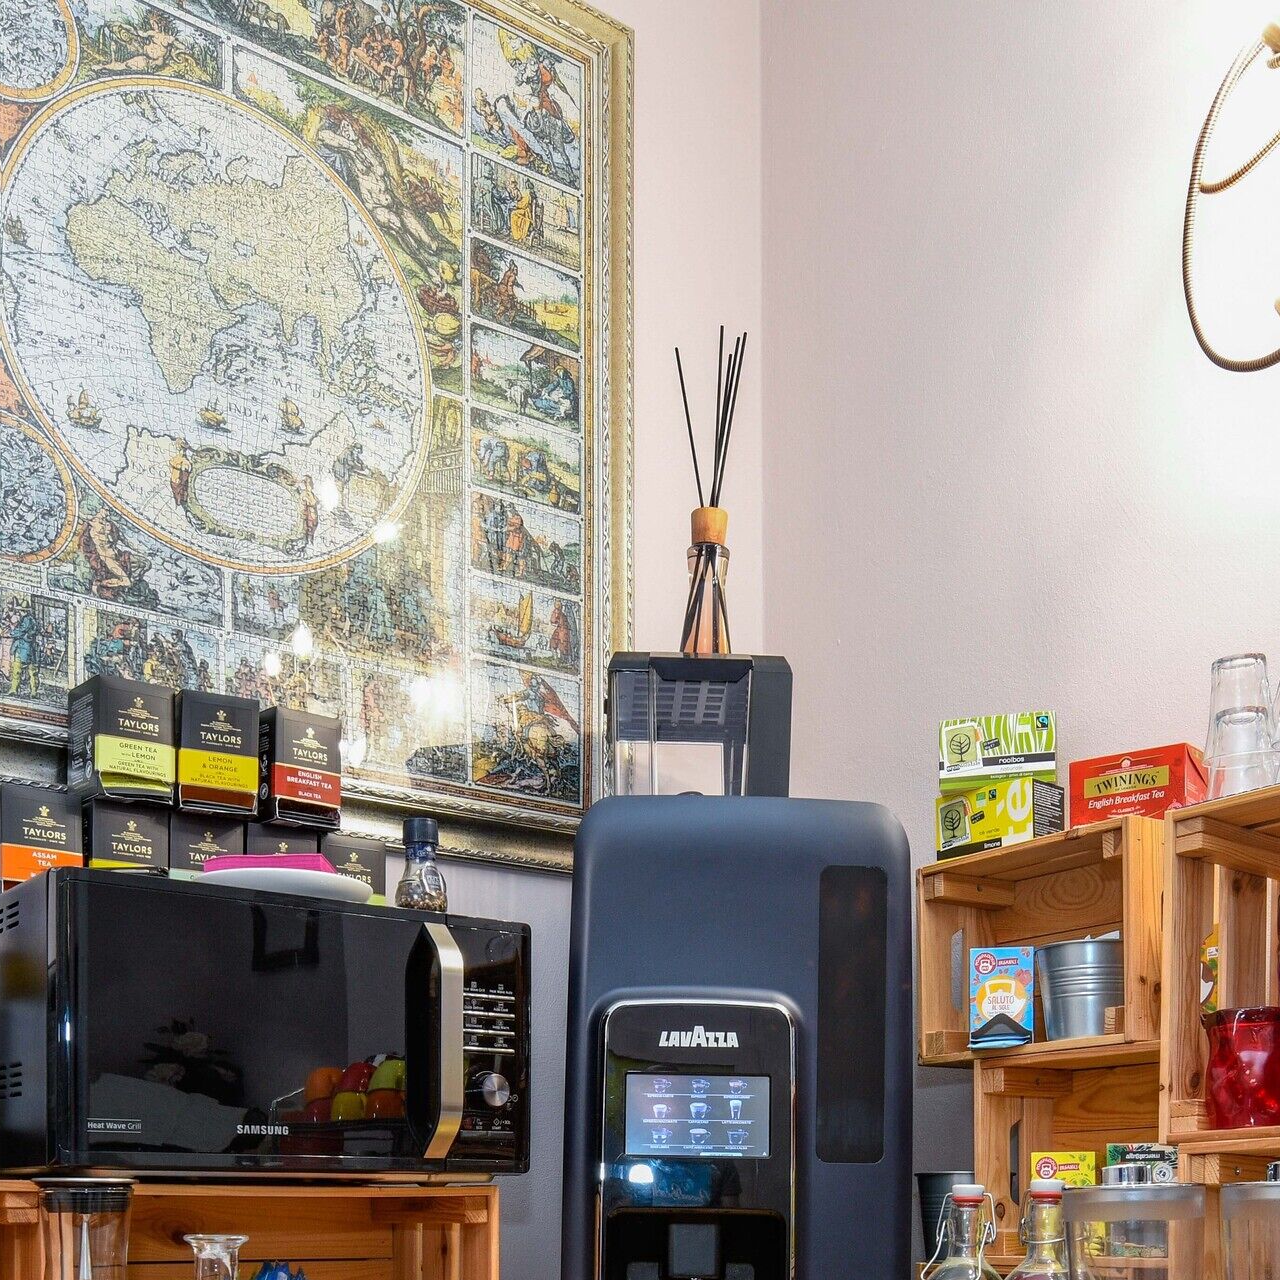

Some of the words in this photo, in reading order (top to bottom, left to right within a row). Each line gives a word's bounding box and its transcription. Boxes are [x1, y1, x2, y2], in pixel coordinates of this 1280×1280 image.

[228, 402, 270, 425] INDIA
[118, 718, 160, 733] TAYLORS
[200, 731, 242, 745] TAYLORS
[119, 742, 143, 752] GREEN
[144, 746, 158, 754] TEA
[131, 751, 156, 761] LEMON
[292, 747, 328, 762] TAYLORS
[208, 756, 232, 764] LEMON
[998, 756, 1025, 764] rooibos
[209, 764, 238, 773] ORANGE
[297, 770, 322, 780] ENGLISH
[286, 776, 320, 787] BREAKFAST
[320, 782, 333, 790] TEA
[1093, 772, 1158, 794] TWININGS
[298, 790, 313, 798] BLACK
[1088, 798, 1115, 810] English
[1114, 793, 1150, 805] Breakfast
[1151, 789, 1165, 799] Tea
[22, 826, 67, 841] TAYLORS
[111, 842, 153, 855] TAYLORS
[983, 841, 1002, 850] limone
[32, 851, 57, 860] ASSAM
[189, 852, 219, 862] TAYL
[37, 859, 52, 868] TEA
[987, 995, 1015, 1005] SALUTO
[659, 1025, 740, 1048] LAVAZZA
[87, 1121, 105, 1130] Heat
[105, 1121, 127, 1130] Wave
[127, 1122, 142, 1130] Grill
[236, 1124, 289, 1135] SAMSUNG
